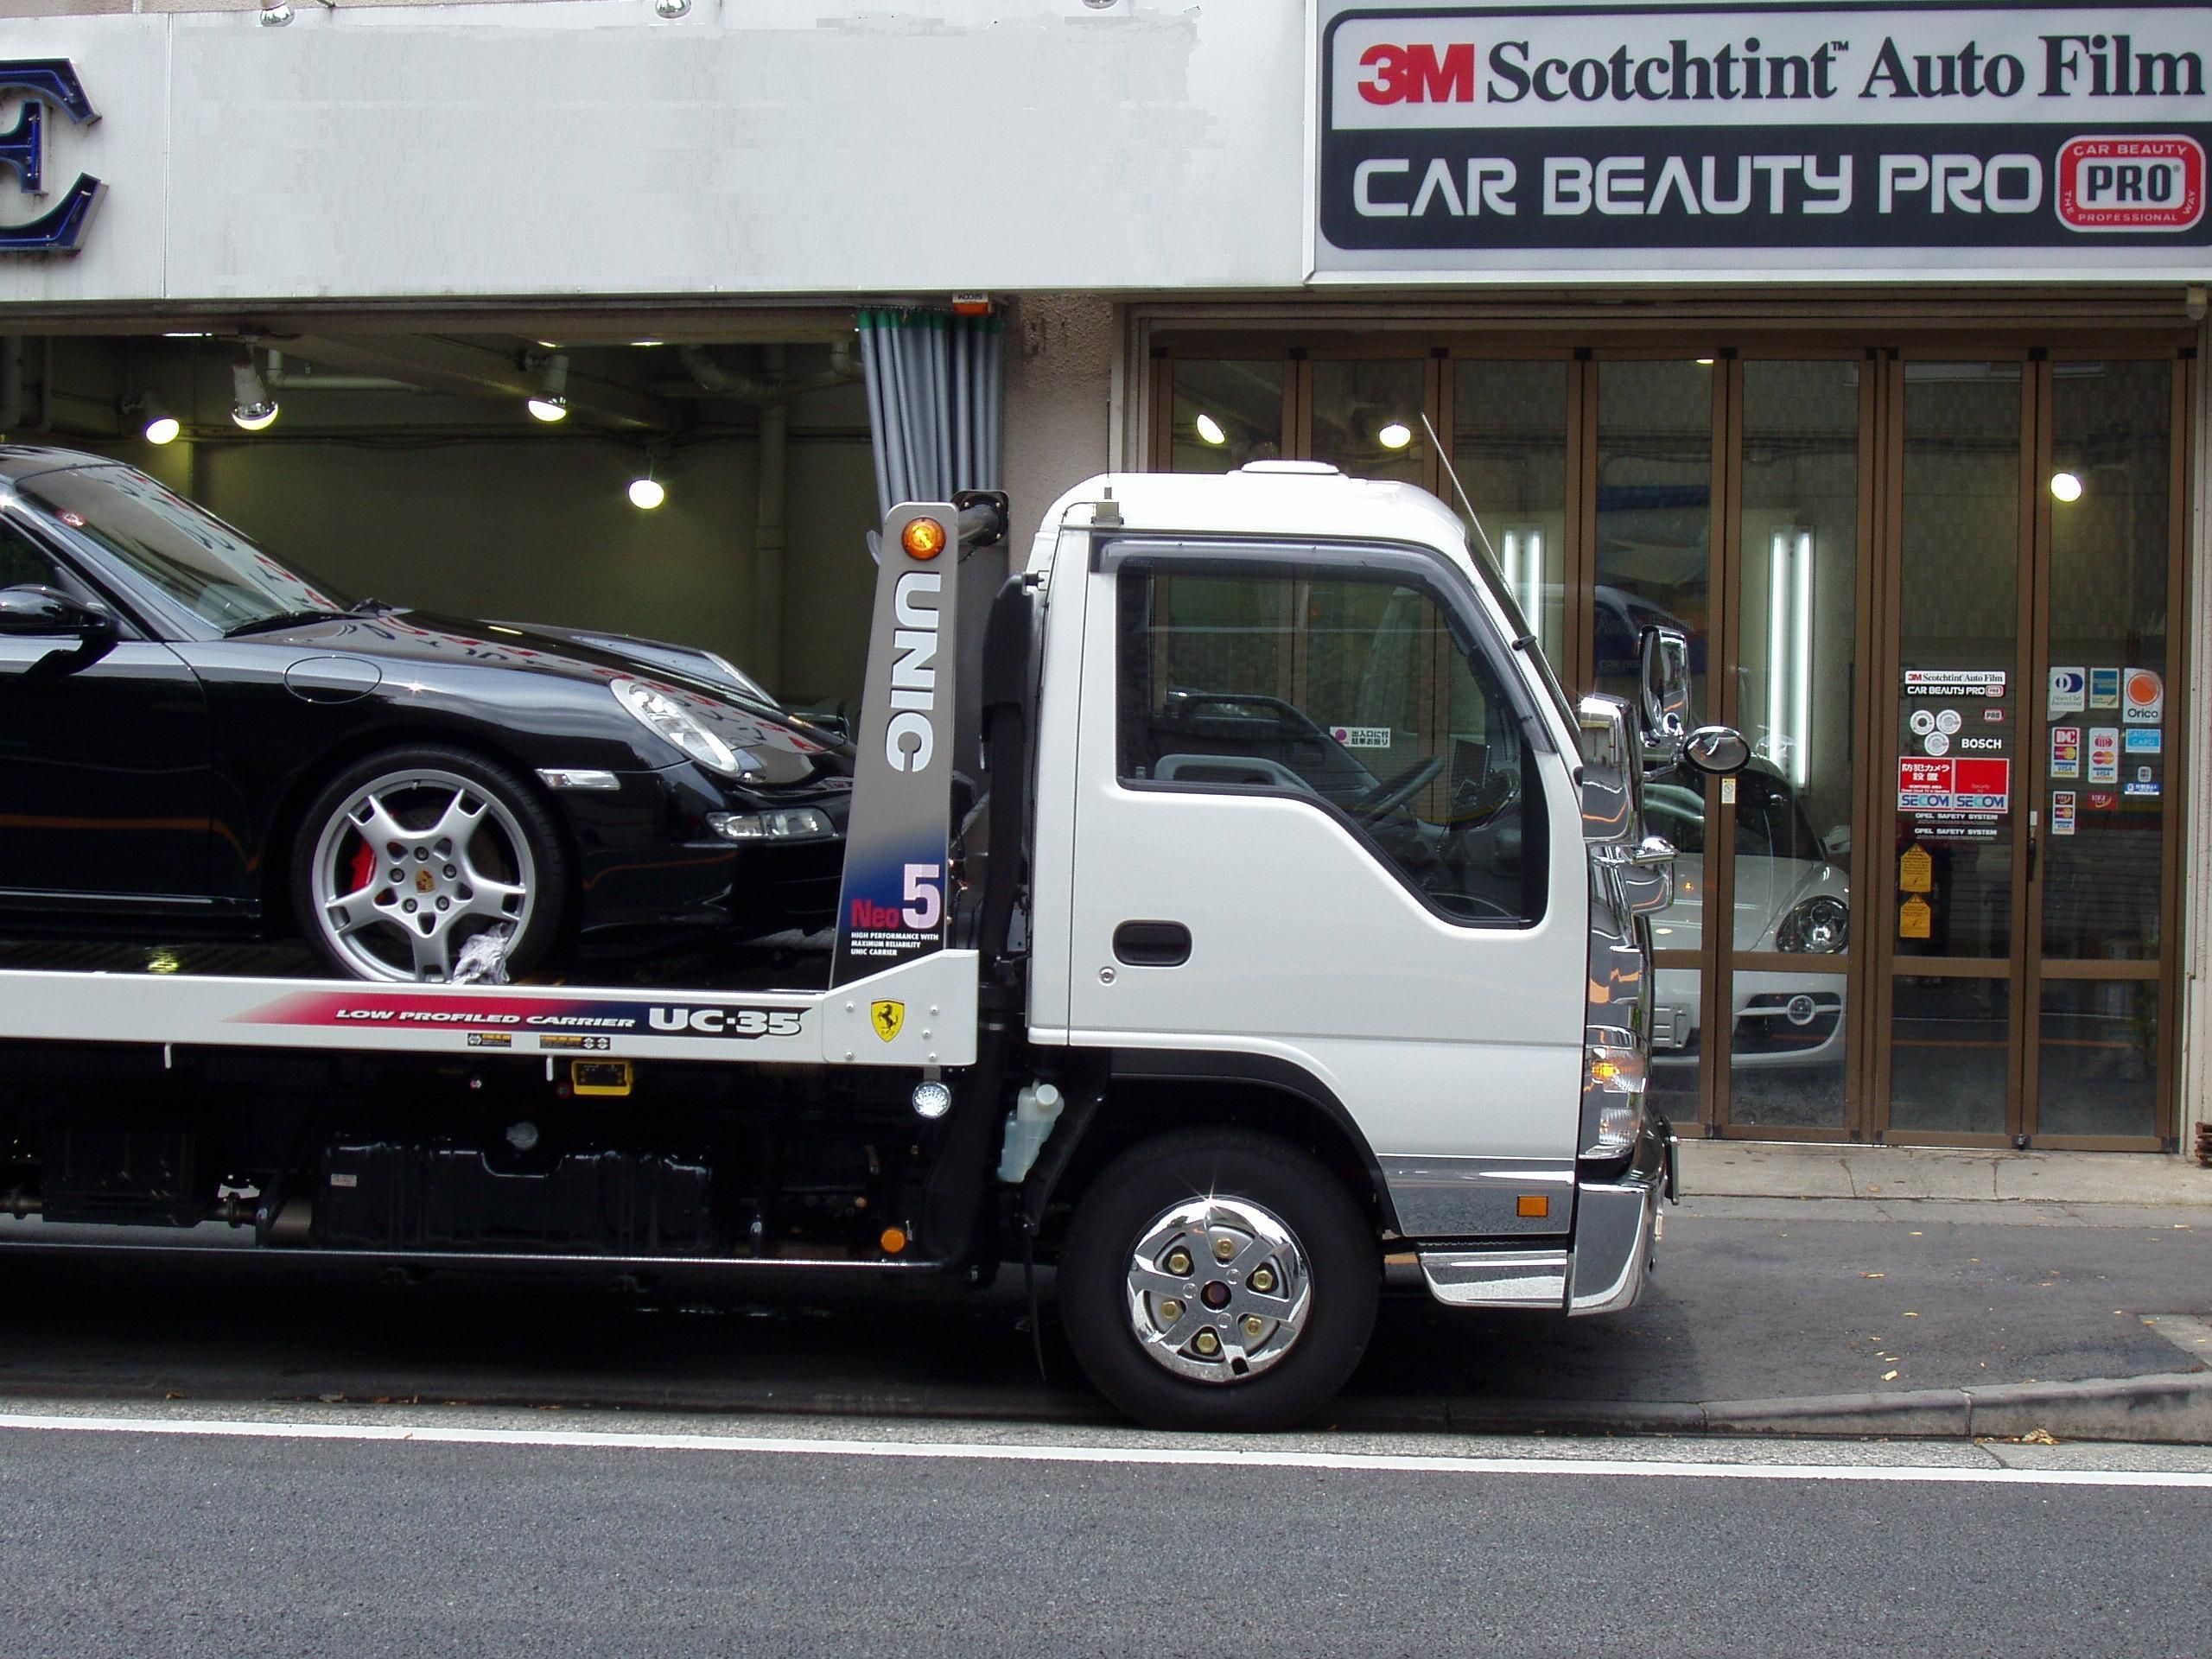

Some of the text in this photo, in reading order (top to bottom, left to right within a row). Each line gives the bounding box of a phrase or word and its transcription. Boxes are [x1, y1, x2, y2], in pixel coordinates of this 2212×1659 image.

[1357, 43, 1475, 105] 3M
[1858, 36, 2024, 98] Auto
[2037, 35, 2205, 97] Film
[2074, 144, 2187, 156] CAR BEAUTY
[1353, 154, 2043, 216] CAR BEAUTY PRO
[2063, 190, 2075, 214] THE
[2183, 190, 2196, 215] WAY
[886, 572, 941, 772] UNIC
[1985, 674, 2003, 683] Film
[1907, 686, 1985, 695] CAR BEAUTY PRO
[2127, 709, 2158, 718] Orico
[1961, 738, 2002, 749] BOSCH
[1901, 795, 1949, 806] SECOM
[1956, 796, 2005, 808] SECOM
[851, 864, 941, 929] Neo 5
[335, 1008, 637, 1029] LOW PROFILED CARRIER
[649, 1007, 802, 1036] UC-35
